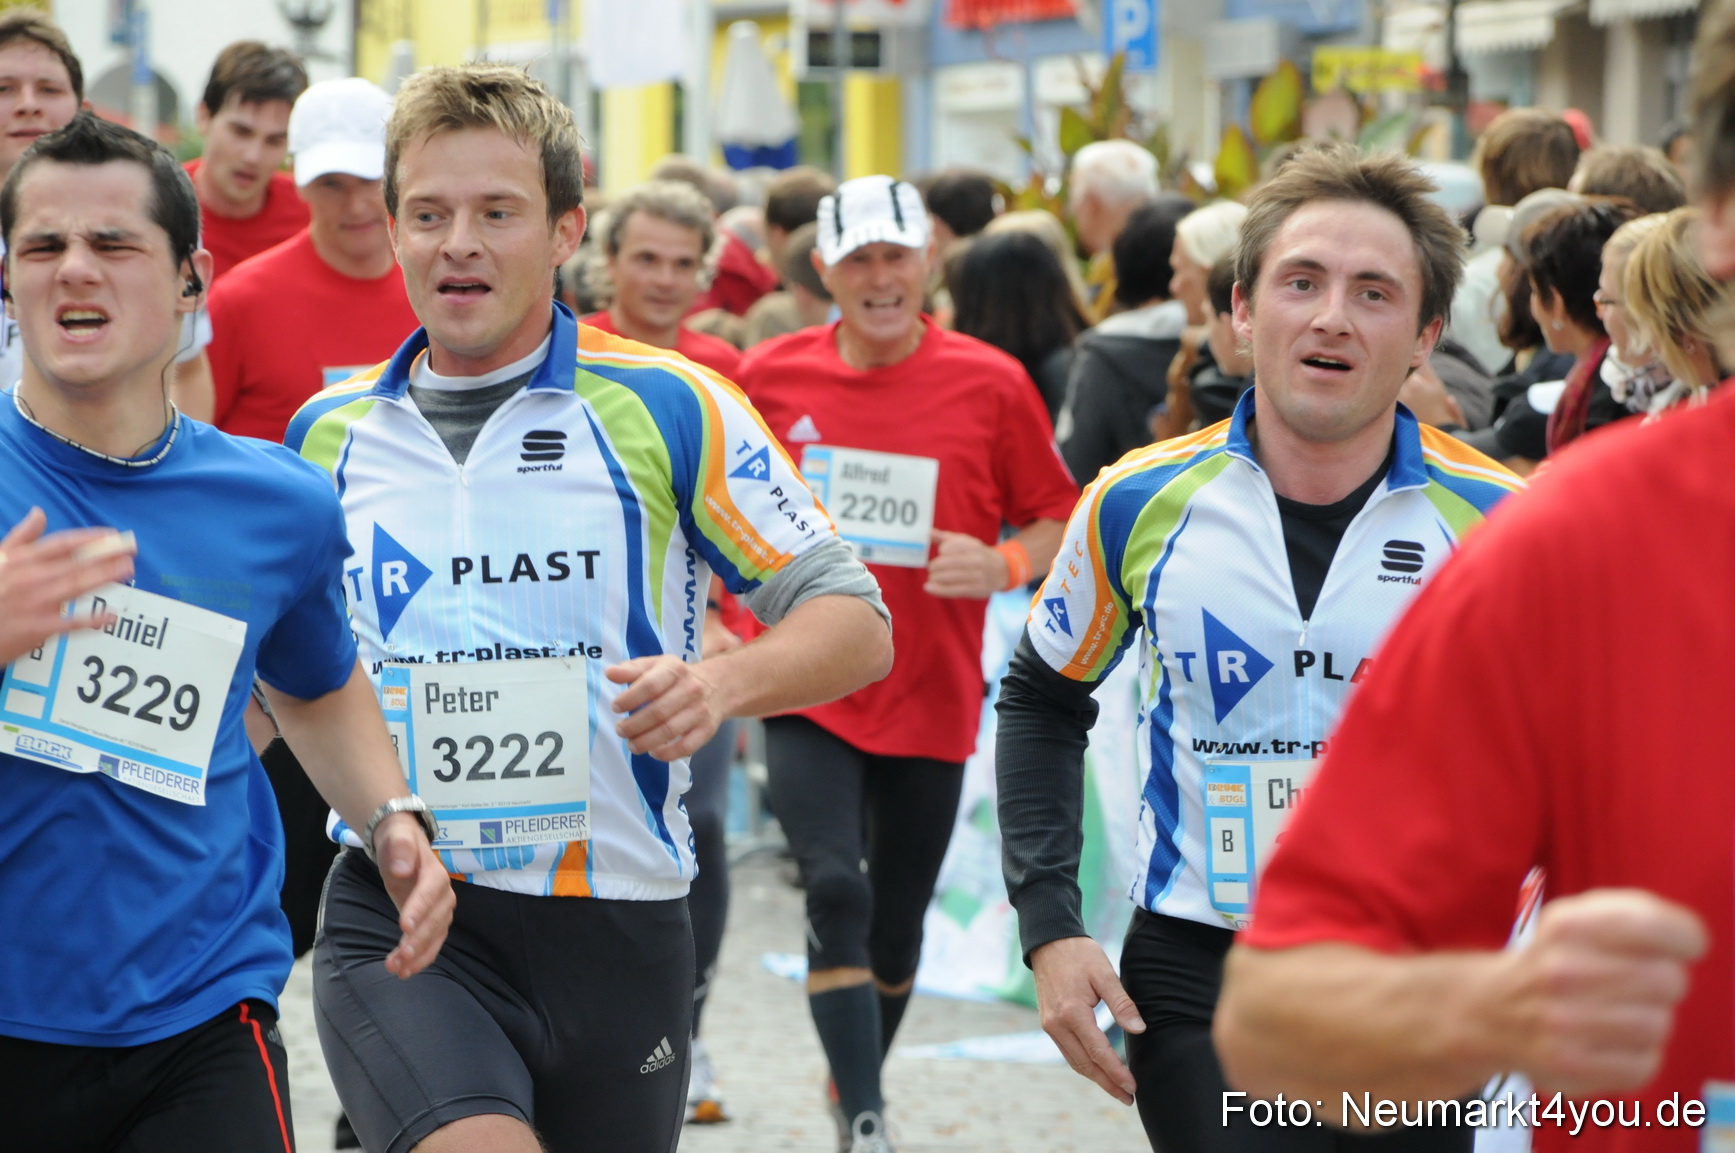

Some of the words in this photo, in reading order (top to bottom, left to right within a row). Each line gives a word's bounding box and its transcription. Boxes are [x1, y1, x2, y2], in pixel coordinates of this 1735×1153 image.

[517, 463, 563, 475] sportful
[841, 462, 891, 485] Alfred
[840, 492, 919, 527] 2200
[451, 550, 601, 585] PLAST
[1060, 540, 1083, 595] TEC
[1377, 574, 1422, 586] sportful
[90, 595, 169, 650] Daniel
[1293, 650, 1374, 684] PLA
[76, 654, 201, 732] 3229
[424, 682, 500, 715] Peter
[15, 734, 73, 761] BOCK
[431, 731, 566, 783] 3222
[1192, 738, 1330, 759] www.tr-p
[121, 760, 201, 795] PFLEIDERER
[505, 813, 587, 834] PFLEIDERER
[505, 830, 588, 844] AKTIENGESELLSCHAFT
[1222, 829, 1234, 852] B
[640, 1052, 676, 1074] adidas
